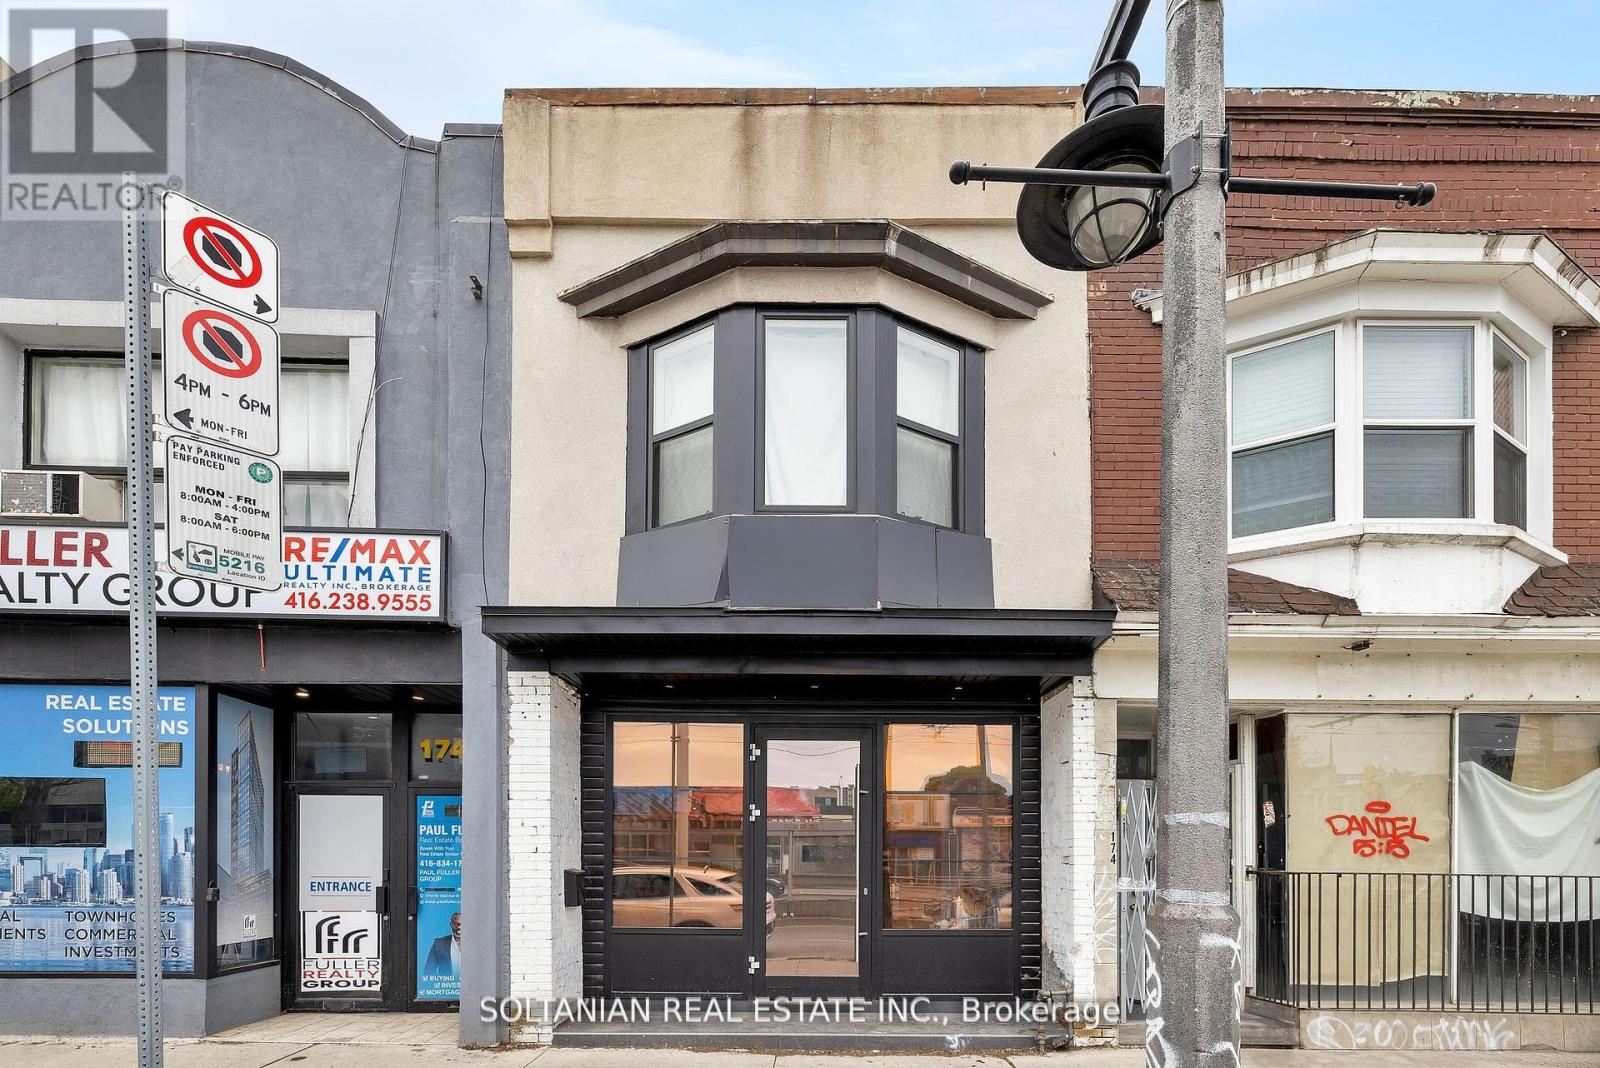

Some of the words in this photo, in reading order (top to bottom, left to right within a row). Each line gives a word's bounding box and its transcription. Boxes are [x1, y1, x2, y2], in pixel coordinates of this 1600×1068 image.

[174, 373, 211, 398] 4PM
[239, 393, 271, 418] 6PM
[173, 441, 193, 453] PAY
[197, 446, 241, 466] PARKING
[173, 452, 225, 471] ENFORCED
[195, 485, 225, 499] MON
[236, 495, 256, 506] FRI
[180, 491, 222, 508] 8:00AM
[232, 504, 270, 518] 4:00PM
[214, 512, 239, 524] SAT
[180, 515, 222, 530] 8:00AM
[232, 526, 270, 540] 6:00PM
[0, 530, 113, 568] LLER
[223, 548, 251, 559] MOBILE
[284, 536, 431, 564] RE/MAX
[219, 555, 266, 574] 5216
[227, 570, 257, 580] Location
[284, 564, 431, 583] ULTIMATE
[361, 583, 431, 591] BROKERAGE
[284, 591, 432, 611] 416.238.9555
[45, 695, 102, 710] REAL
[108, 695, 186, 711] ESTE
[63, 718, 189, 735] SOLUTNS
[419, 824, 448, 835] PAUL
[1325, 815, 1430, 841] DANIEL
[310, 881, 372, 892] ENTRANCE
[0, 928, 46, 940] ENTS
[64, 928, 177, 940] COMMERAL
[64, 946, 180, 958] INVESTMTS
[303, 960, 380, 970] FULLER
[303, 970, 379, 979] REALTY
[303, 980, 380, 988] GROUP
